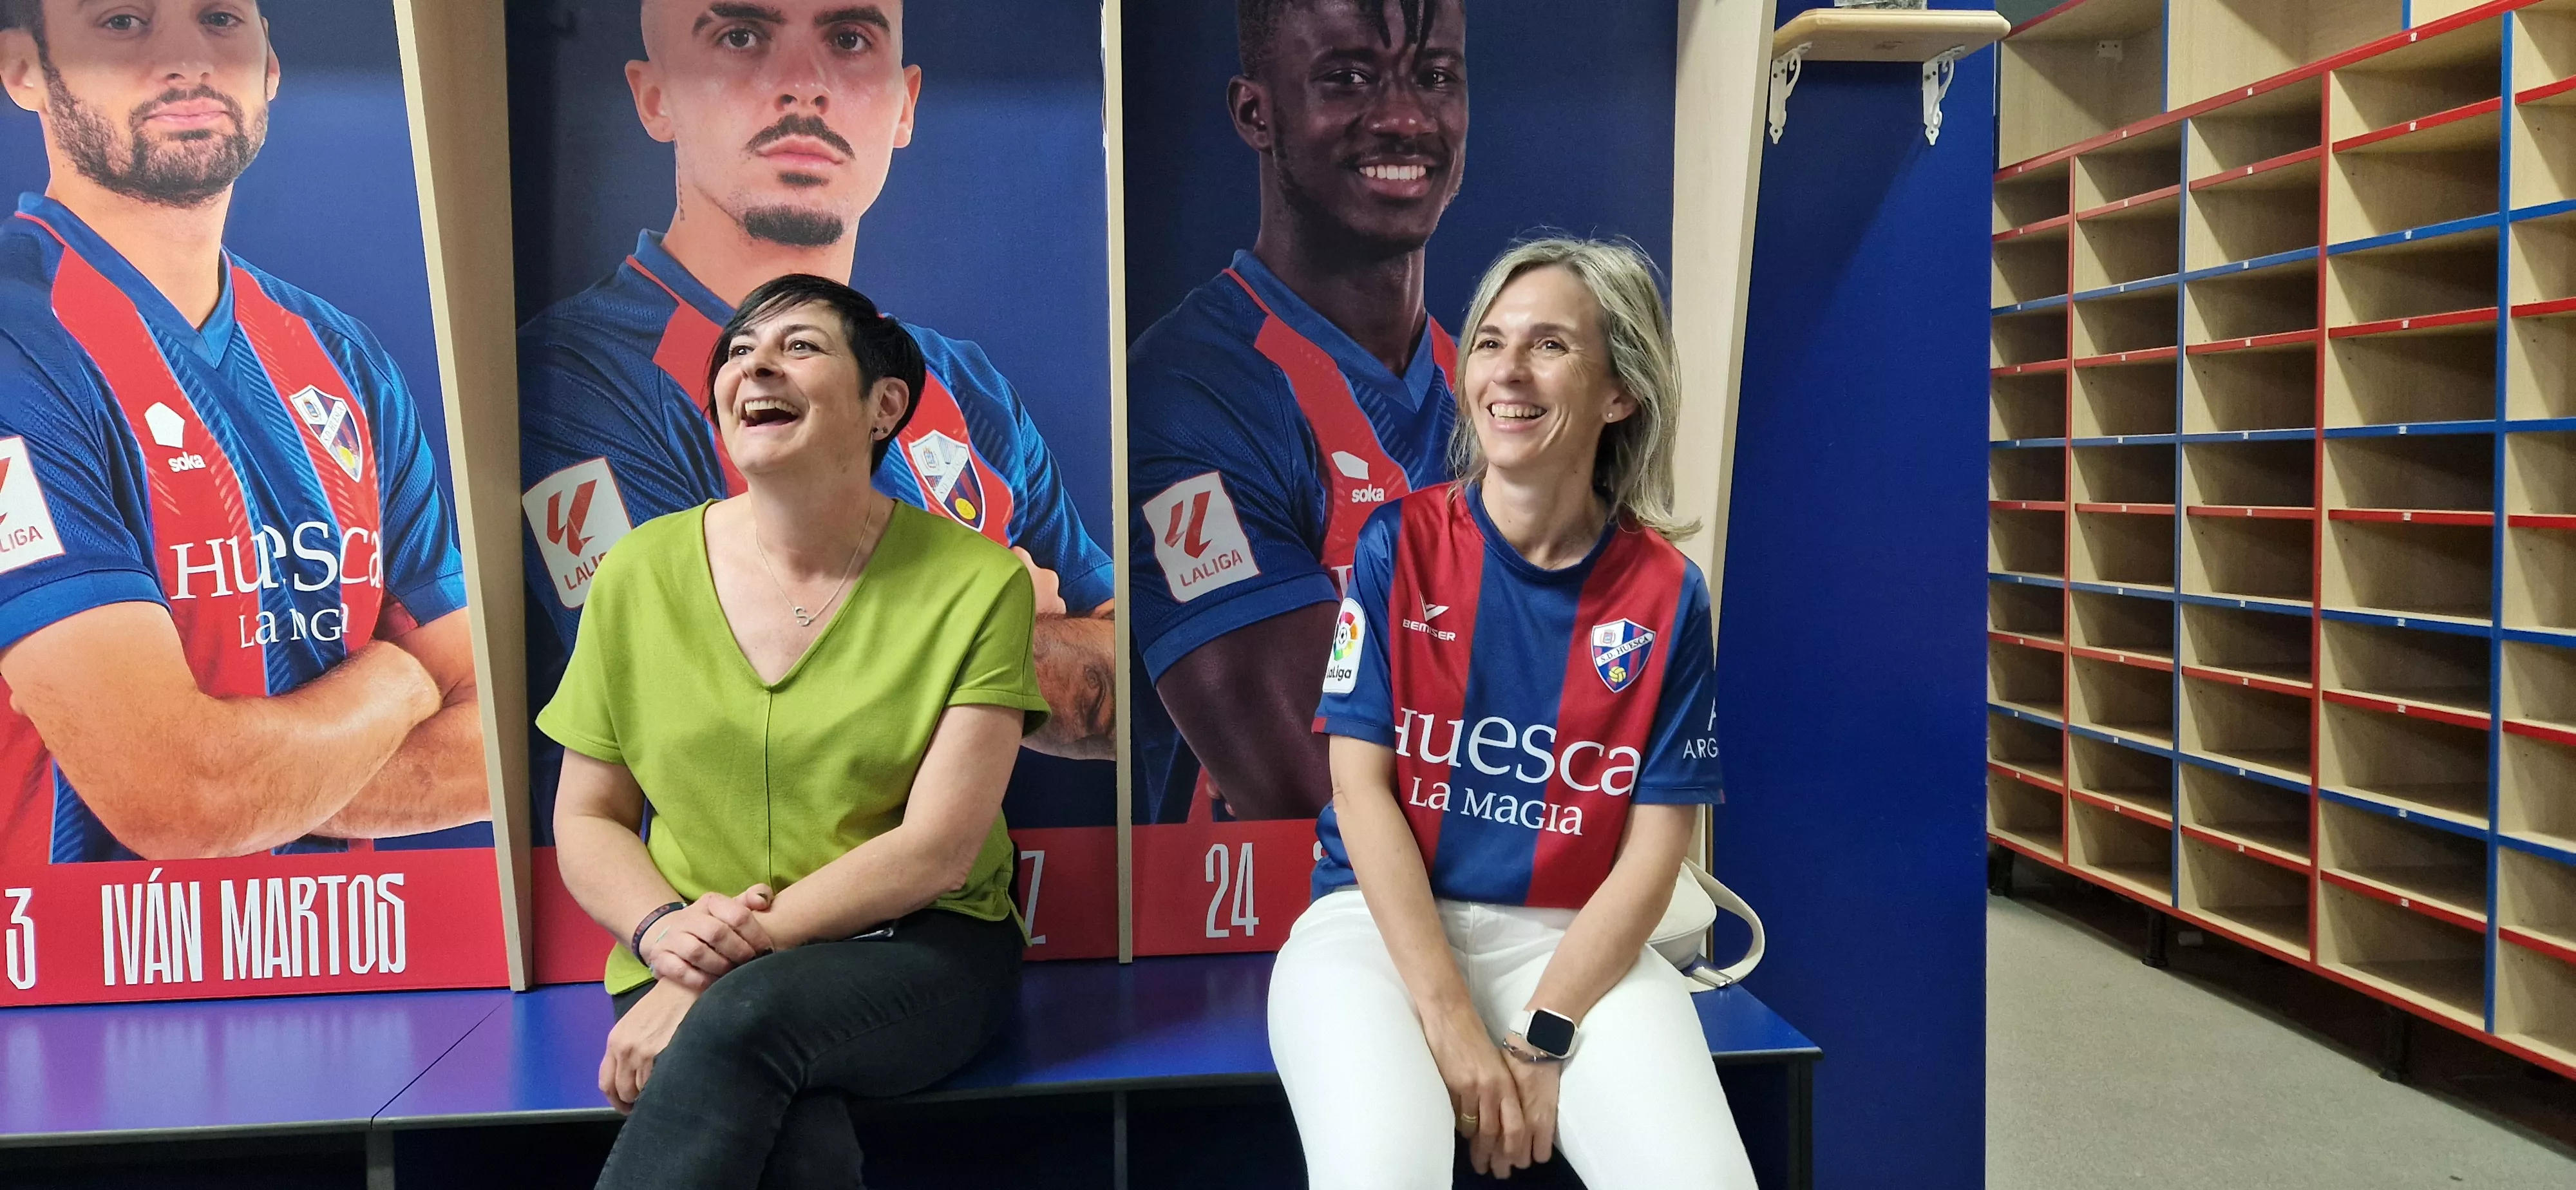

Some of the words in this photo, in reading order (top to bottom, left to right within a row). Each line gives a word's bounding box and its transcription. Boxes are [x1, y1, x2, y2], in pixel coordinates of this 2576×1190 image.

[168, 451, 206, 473] soka
[1351, 484, 1385, 503] soka
[1179, 549, 1243, 587] LALIGA
[1402, 618, 1457, 641] BEMISER
[1616, 636, 1649, 655] HUESCA
[1394, 706, 1641, 797] Huesca
[1683, 738, 1719, 759] ARG
[1408, 777, 1451, 811] La
[1205, 842, 1260, 938] 24
[5, 887, 36, 990] 3
[100, 867, 203, 987] IVÁN
[221, 873, 406, 981] MARTOS
